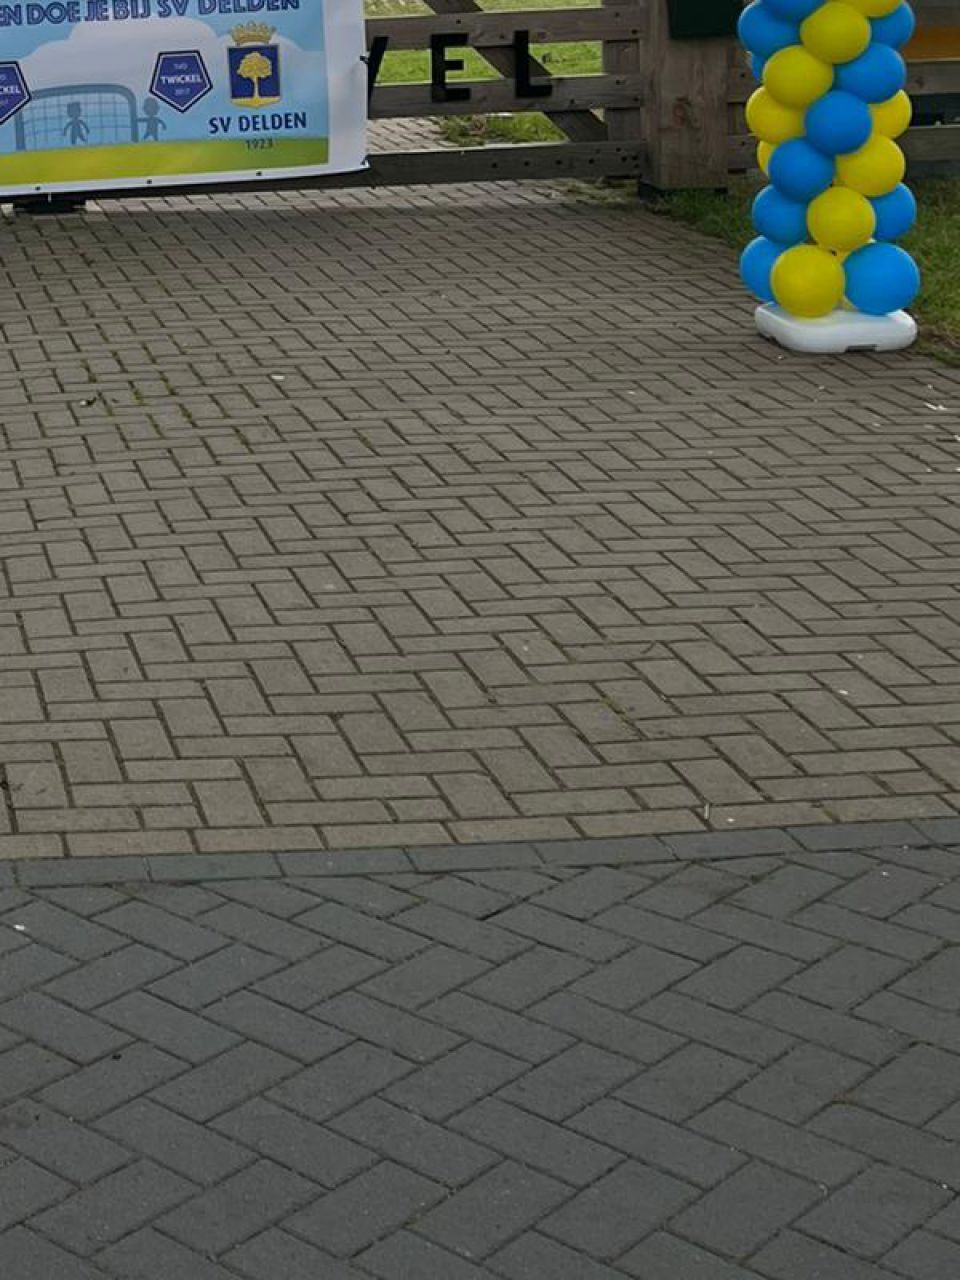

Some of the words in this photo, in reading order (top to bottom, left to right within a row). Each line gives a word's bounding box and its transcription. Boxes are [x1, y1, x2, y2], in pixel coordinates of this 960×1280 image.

[26, 1, 81, 25] DOE
[85, 0, 108, 22] JE
[159, 73, 203, 85] TWICKEL
[209, 117, 231, 135] SV
[238, 112, 307, 132] DELDEN
[246, 138, 273, 150] 1923
